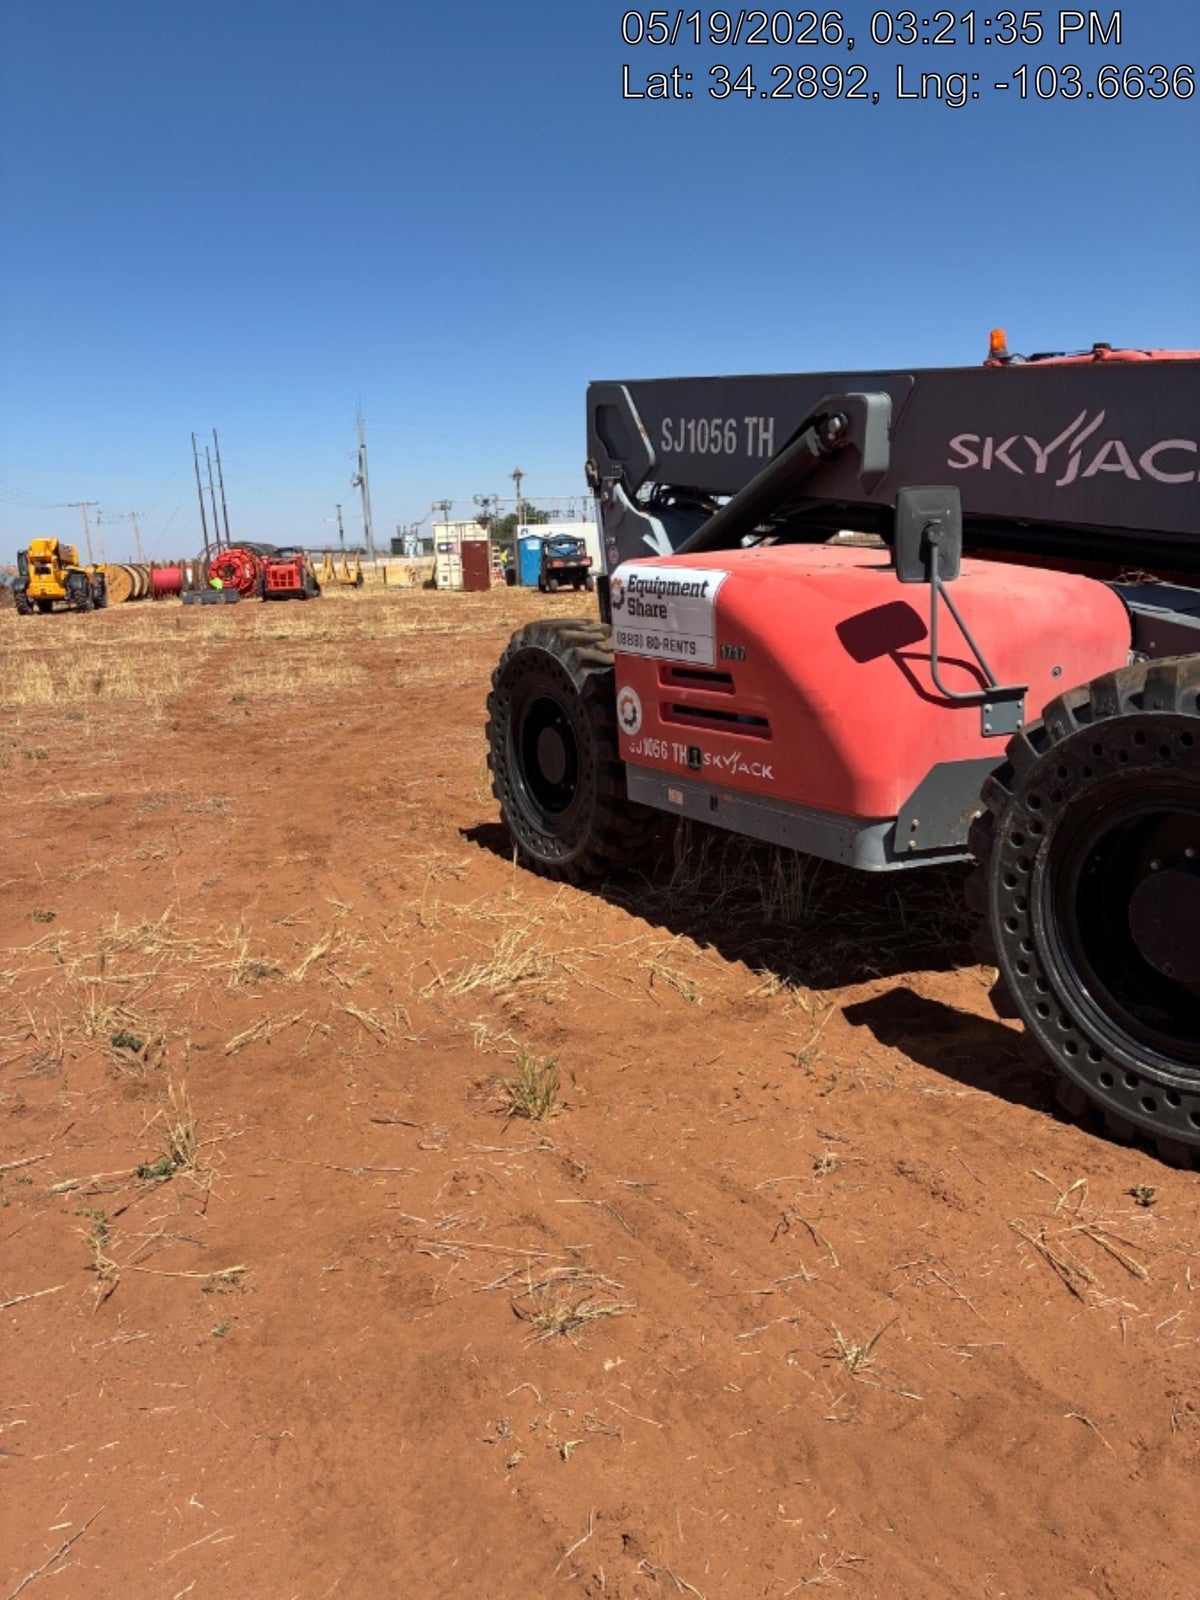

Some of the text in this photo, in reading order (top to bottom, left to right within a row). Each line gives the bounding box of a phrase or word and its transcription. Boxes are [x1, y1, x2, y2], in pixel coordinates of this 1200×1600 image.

[661, 416, 775, 458] SJ1056 TH
[947, 408, 1200, 487] SKYJAC
[627, 574, 709, 599] Equipment
[627, 598, 668, 619] Share
[703, 751, 775, 780] SKYJACK
